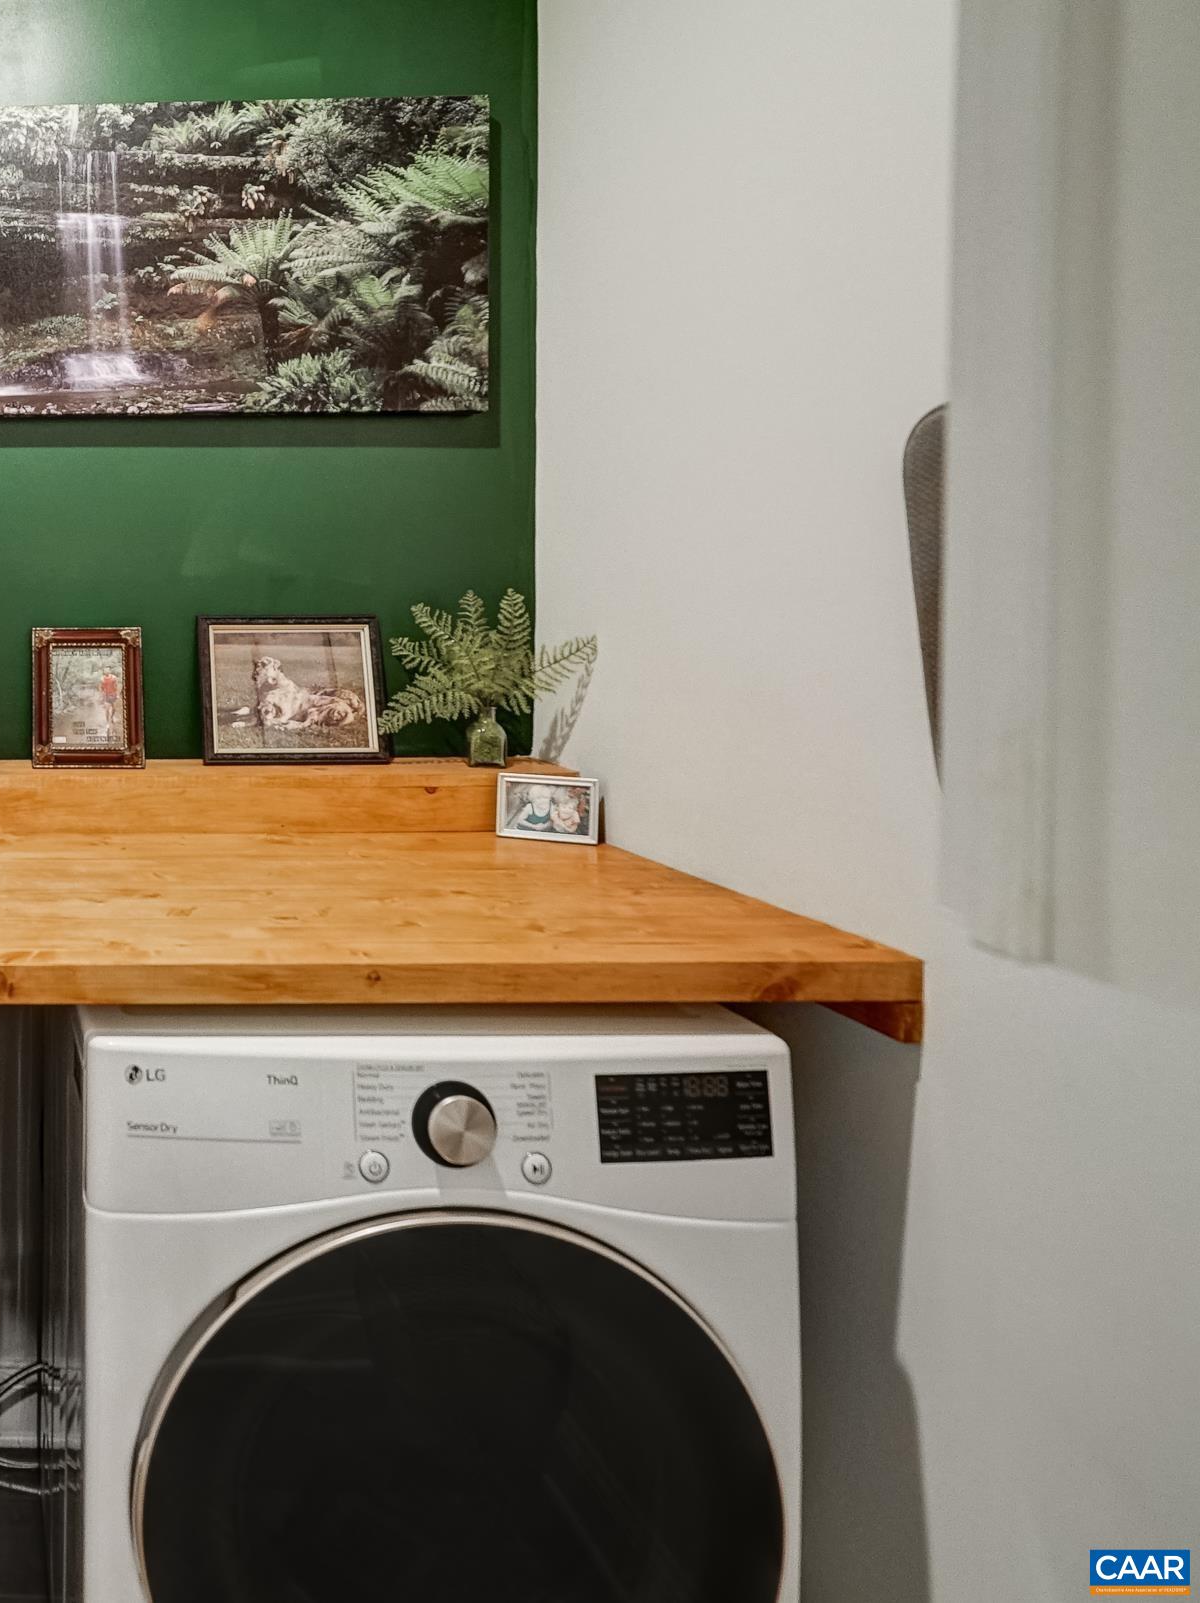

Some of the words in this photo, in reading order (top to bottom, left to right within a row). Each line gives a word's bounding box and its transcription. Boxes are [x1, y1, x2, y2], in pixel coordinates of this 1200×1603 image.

[146, 1068, 166, 1082] LG
[266, 1074, 298, 1086] ThinQ
[126, 1120, 158, 1132] Sensor
[160, 1122, 178, 1134] Dry
